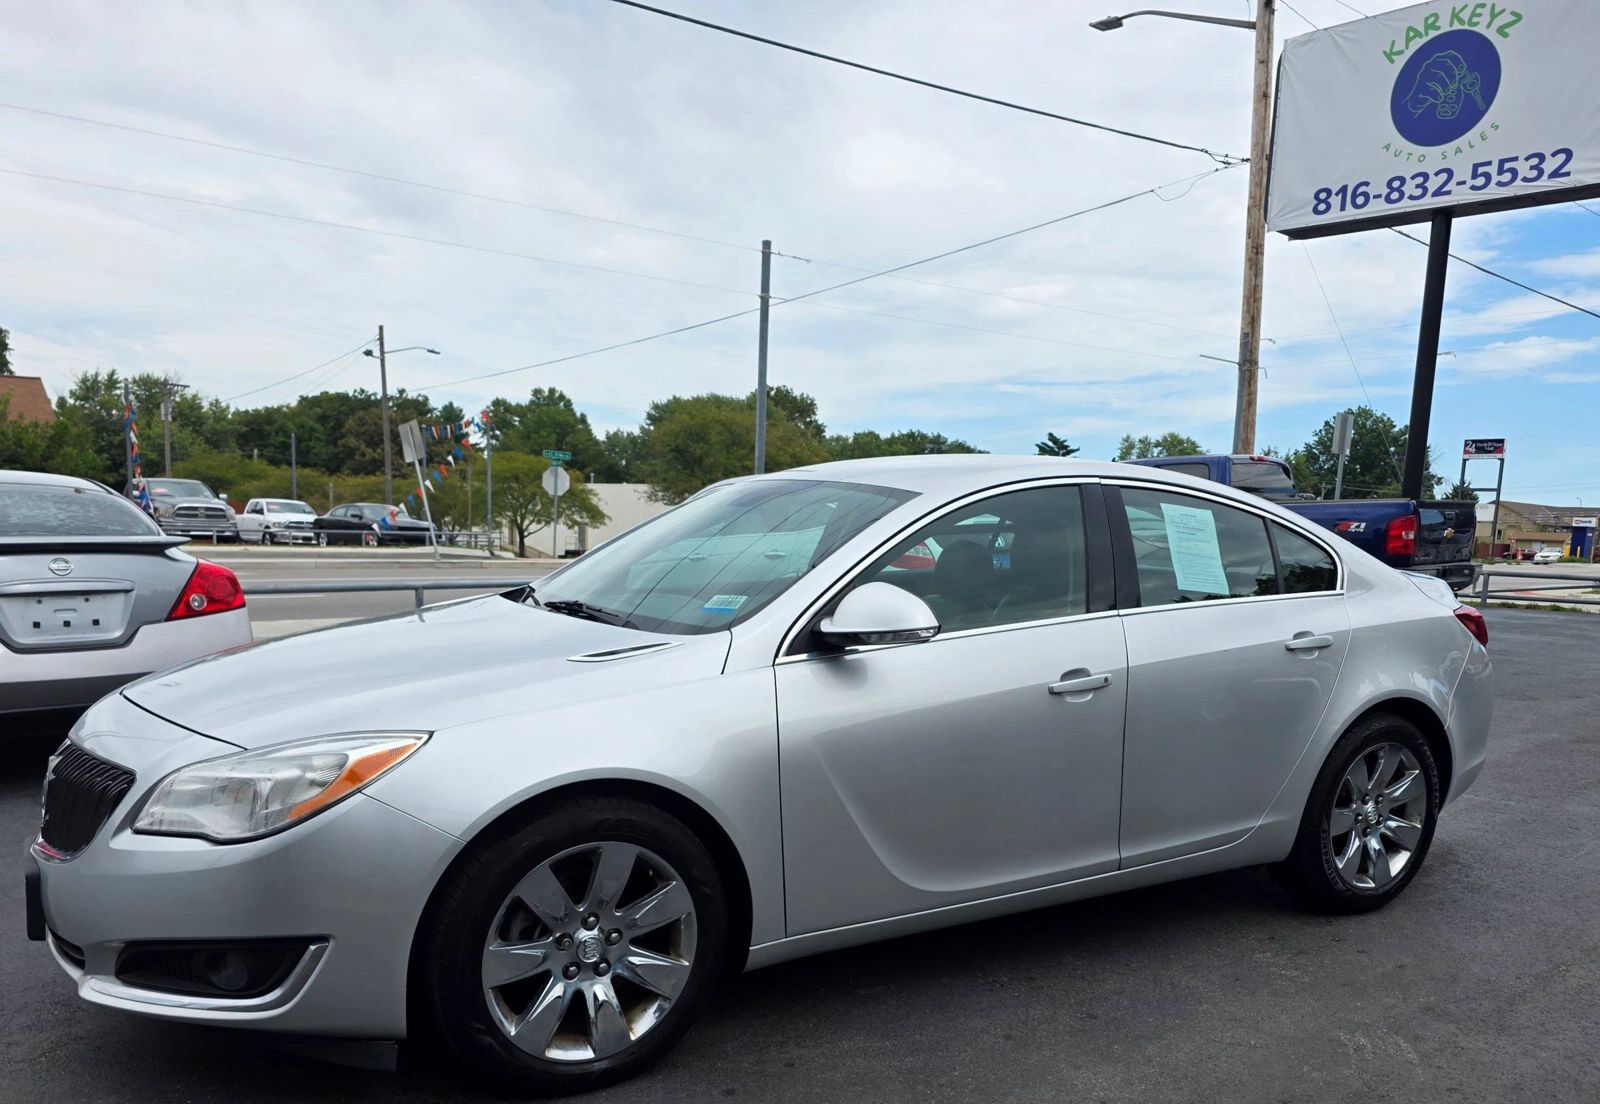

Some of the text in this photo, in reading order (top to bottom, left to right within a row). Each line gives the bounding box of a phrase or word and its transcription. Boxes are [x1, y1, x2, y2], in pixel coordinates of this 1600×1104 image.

[1382, 2, 1523, 64] KAR KEYZ
[1381, 121, 1500, 163] AUTO SALES
[1312, 147, 1574, 216] 816-832-5532
